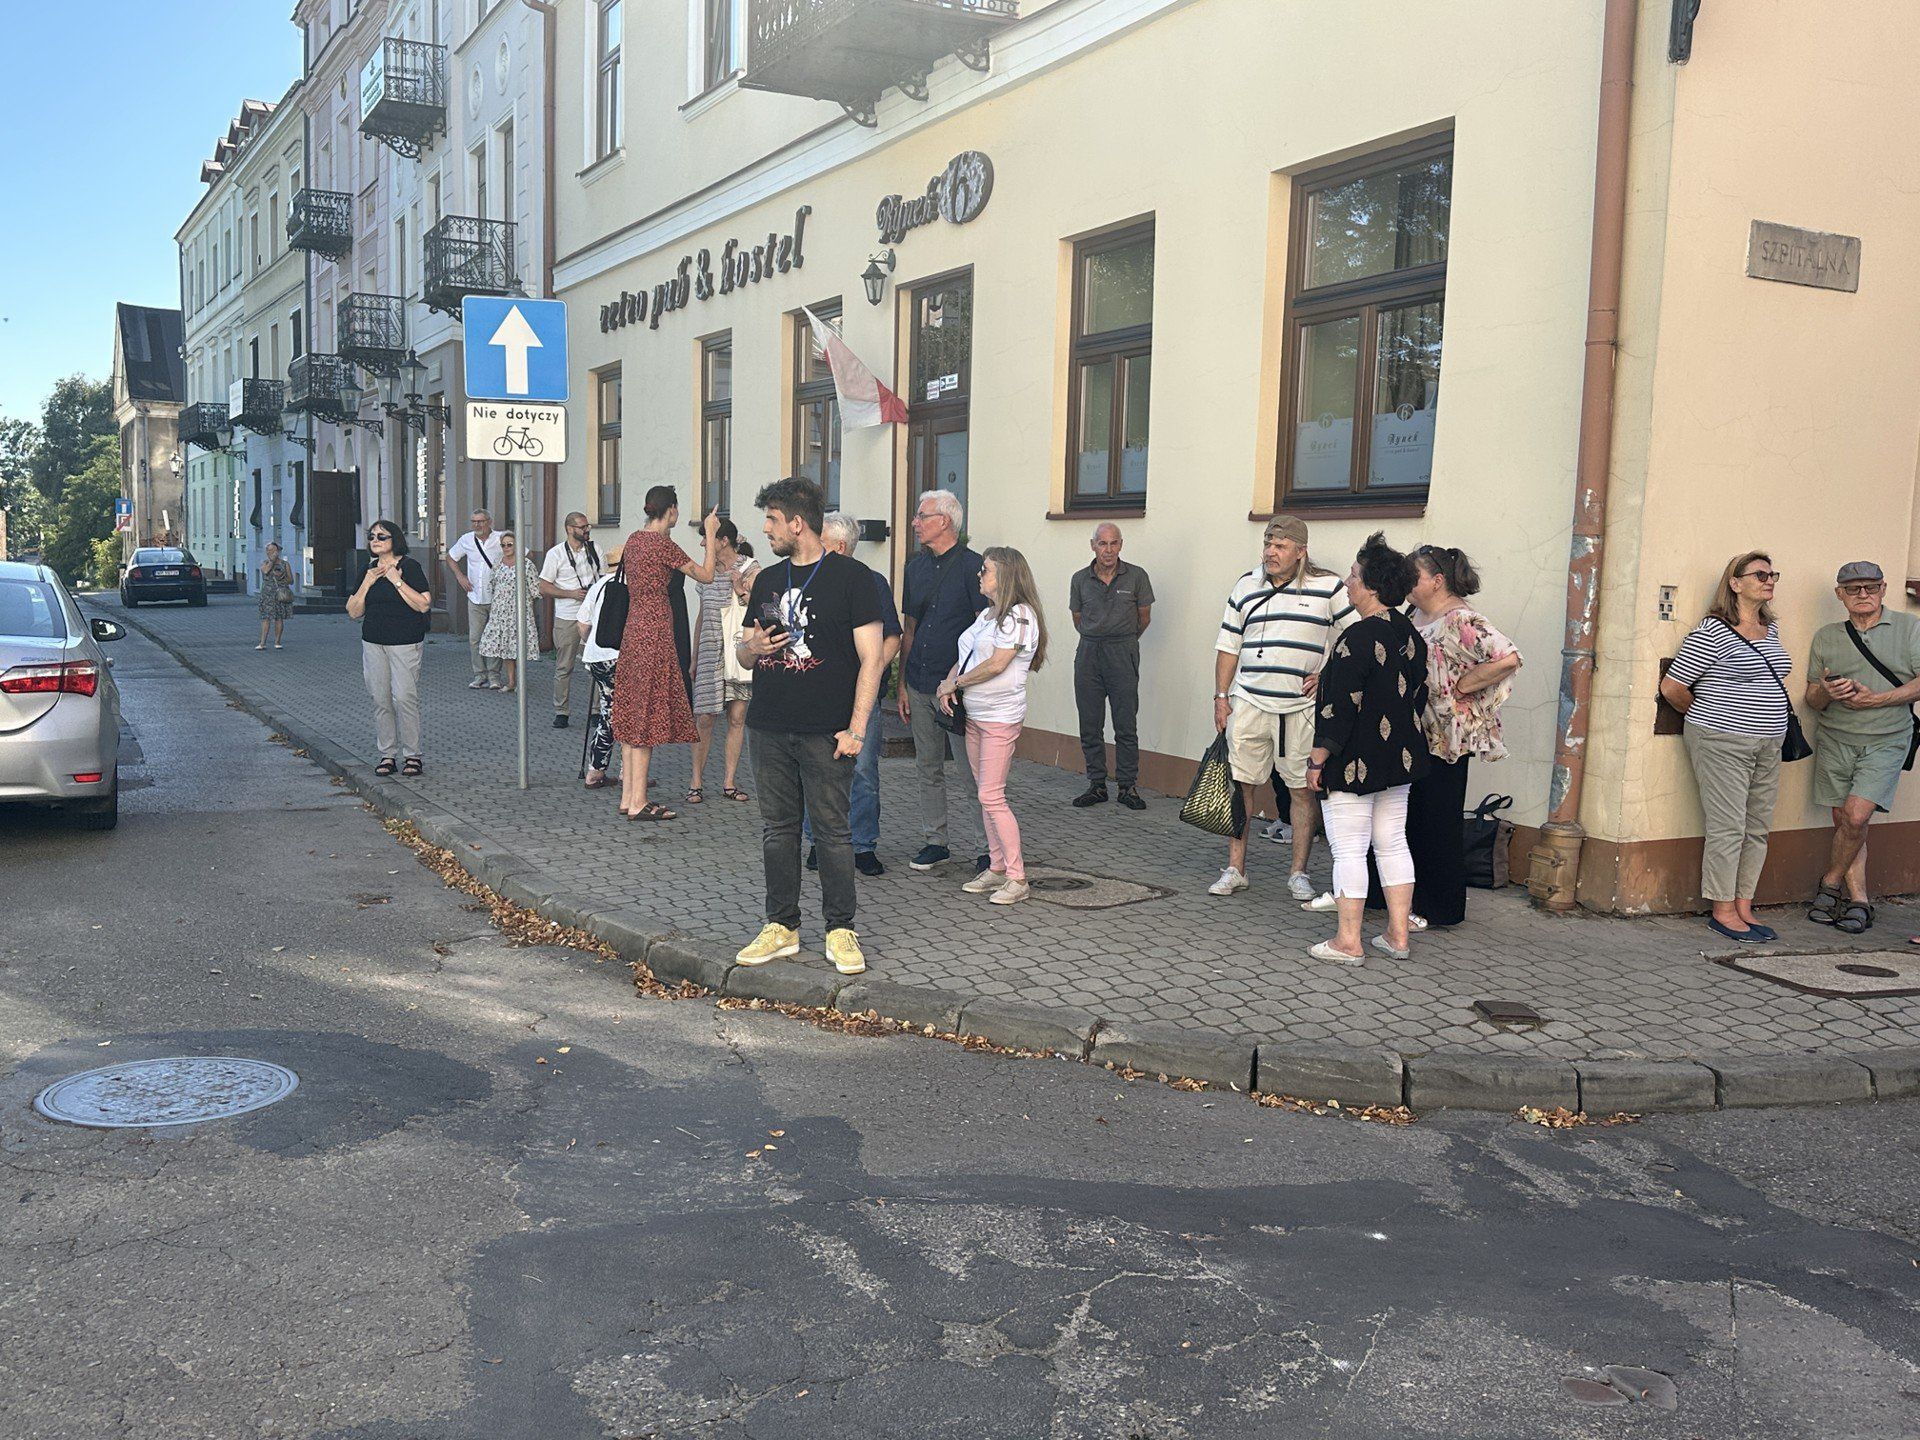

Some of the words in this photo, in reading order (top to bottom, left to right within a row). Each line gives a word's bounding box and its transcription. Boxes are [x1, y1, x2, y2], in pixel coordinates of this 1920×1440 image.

[876, 176, 940, 244] Rynek
[600, 291, 648, 333] retro
[650, 256, 692, 330] pub
[696, 248, 714, 301] &
[719, 205, 812, 295] hostel
[1762, 240, 1850, 275] SZPITALNA
[473, 406, 497, 419] Nie
[506, 408, 559, 425] dotyczy
